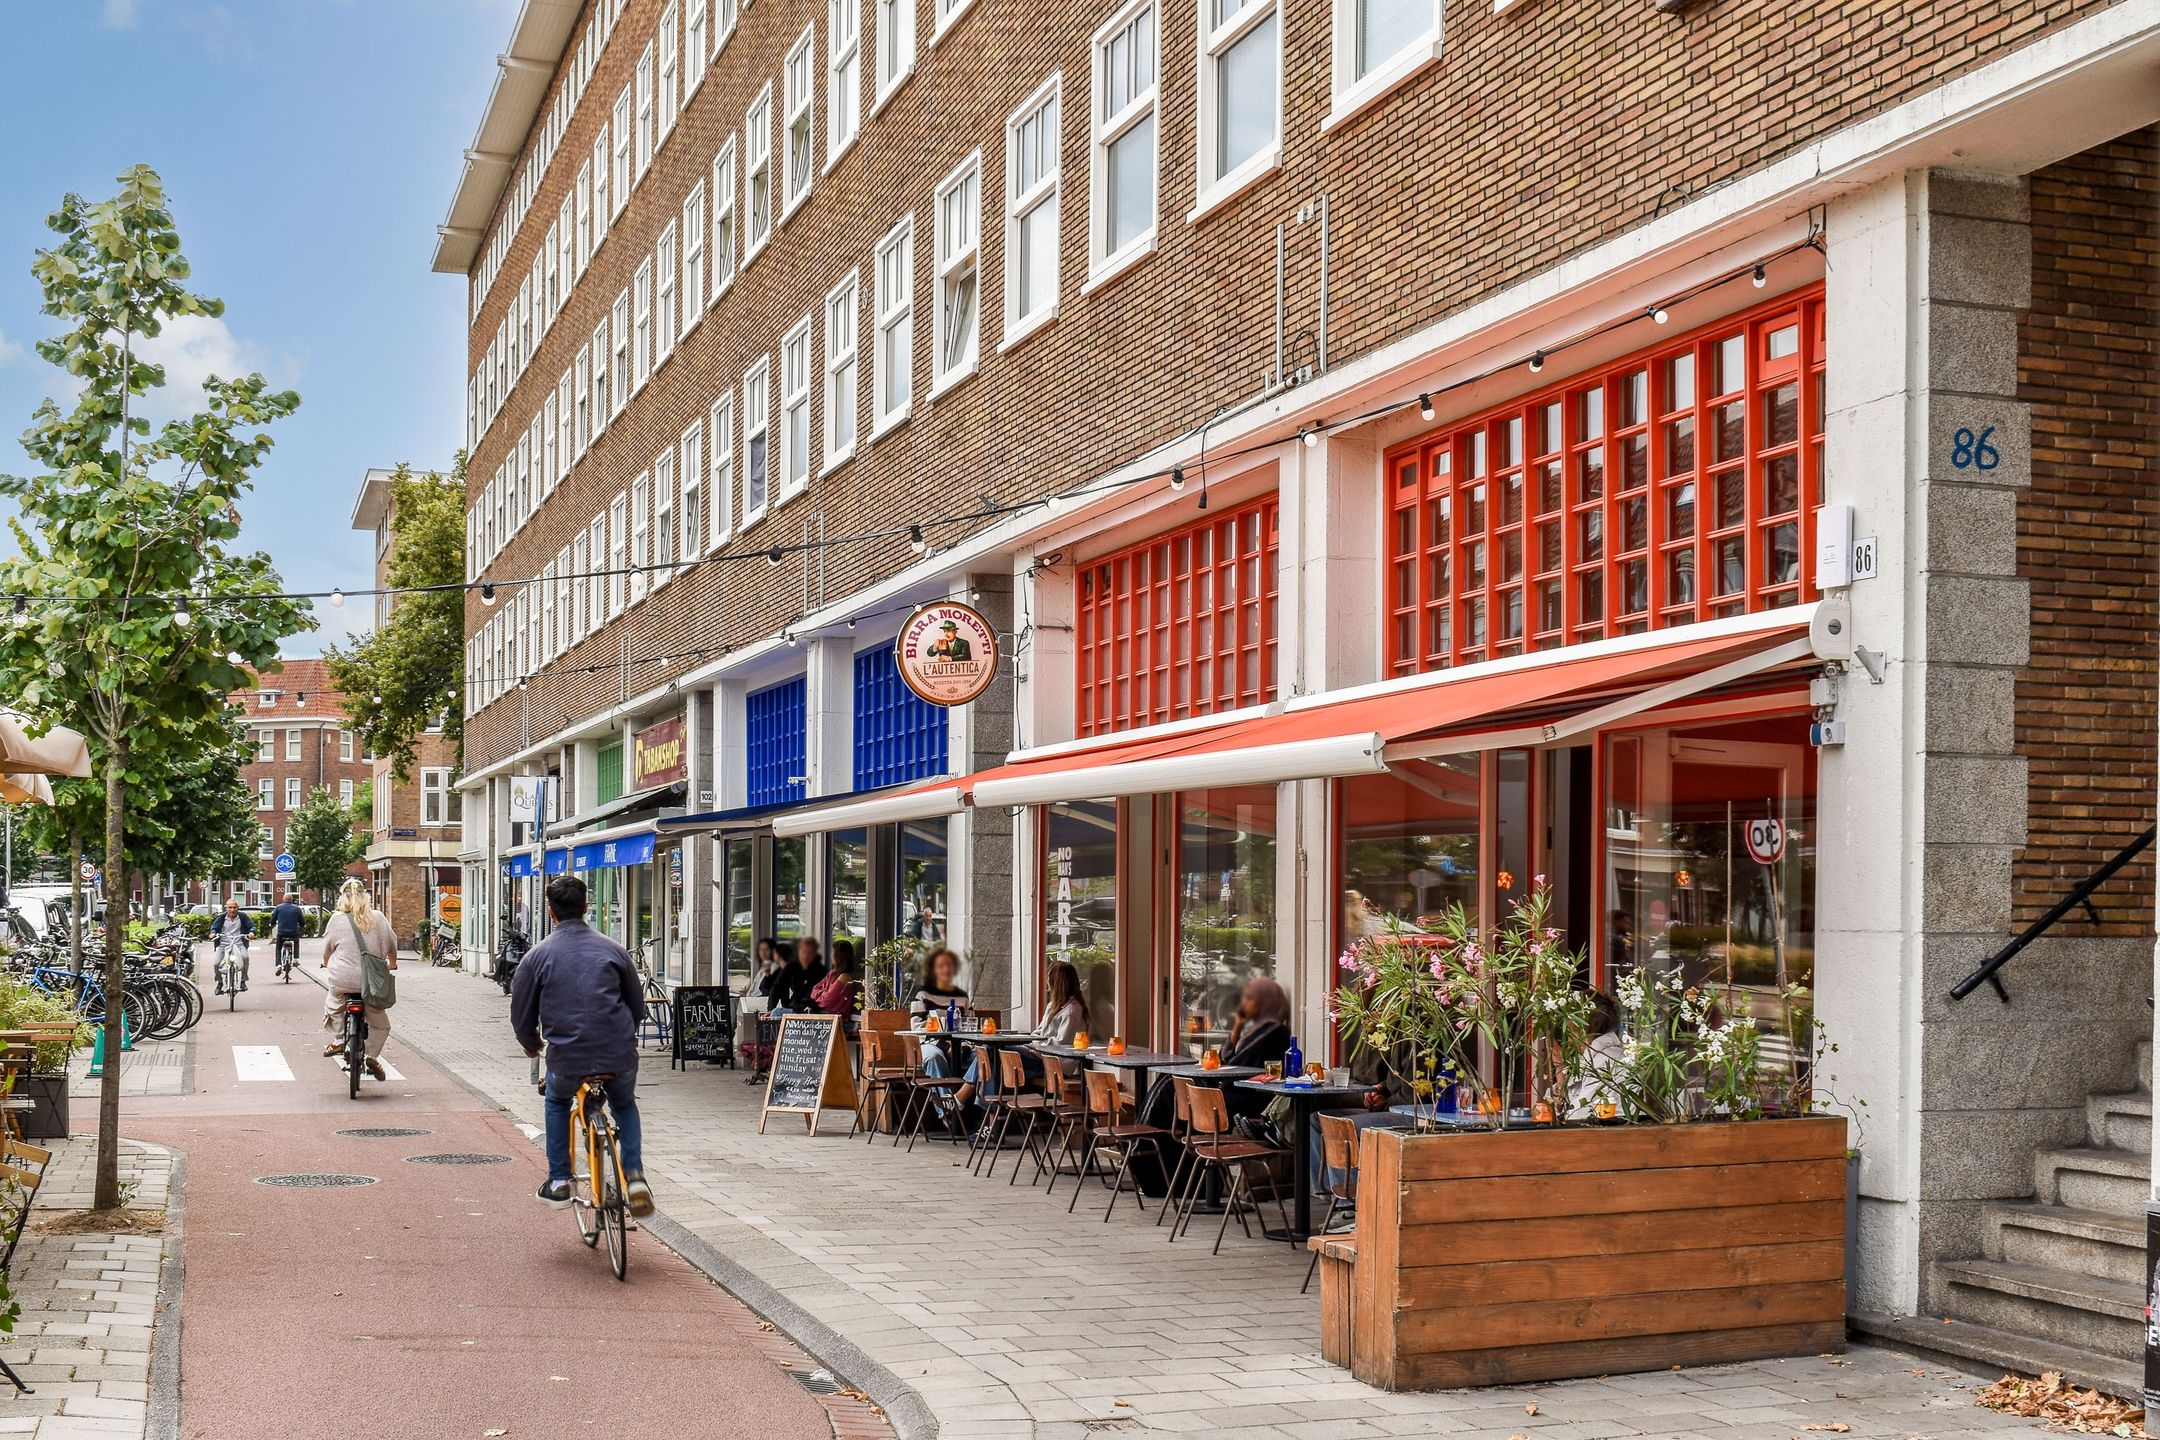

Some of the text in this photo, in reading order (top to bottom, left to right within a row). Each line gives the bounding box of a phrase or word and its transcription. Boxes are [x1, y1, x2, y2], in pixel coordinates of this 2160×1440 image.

[1951, 425, 2000, 470] 86
[1855, 544, 1871, 573] 86
[905, 609, 991, 659] BIRRA MORETTI
[923, 662, 979, 676] L'AUTENTICA
[644, 739, 680, 775] TABAKSHOP
[514, 796, 553, 809] QUES
[1058, 846, 1072, 860] NO
[82, 866, 94, 874] 30
[785, 1029, 801, 1037] open
[802, 1028, 817, 1038] daily
[783, 1037, 810, 1047] monday
[779, 1063, 807, 1074] sunday
[776, 1073, 801, 1087] Happy
